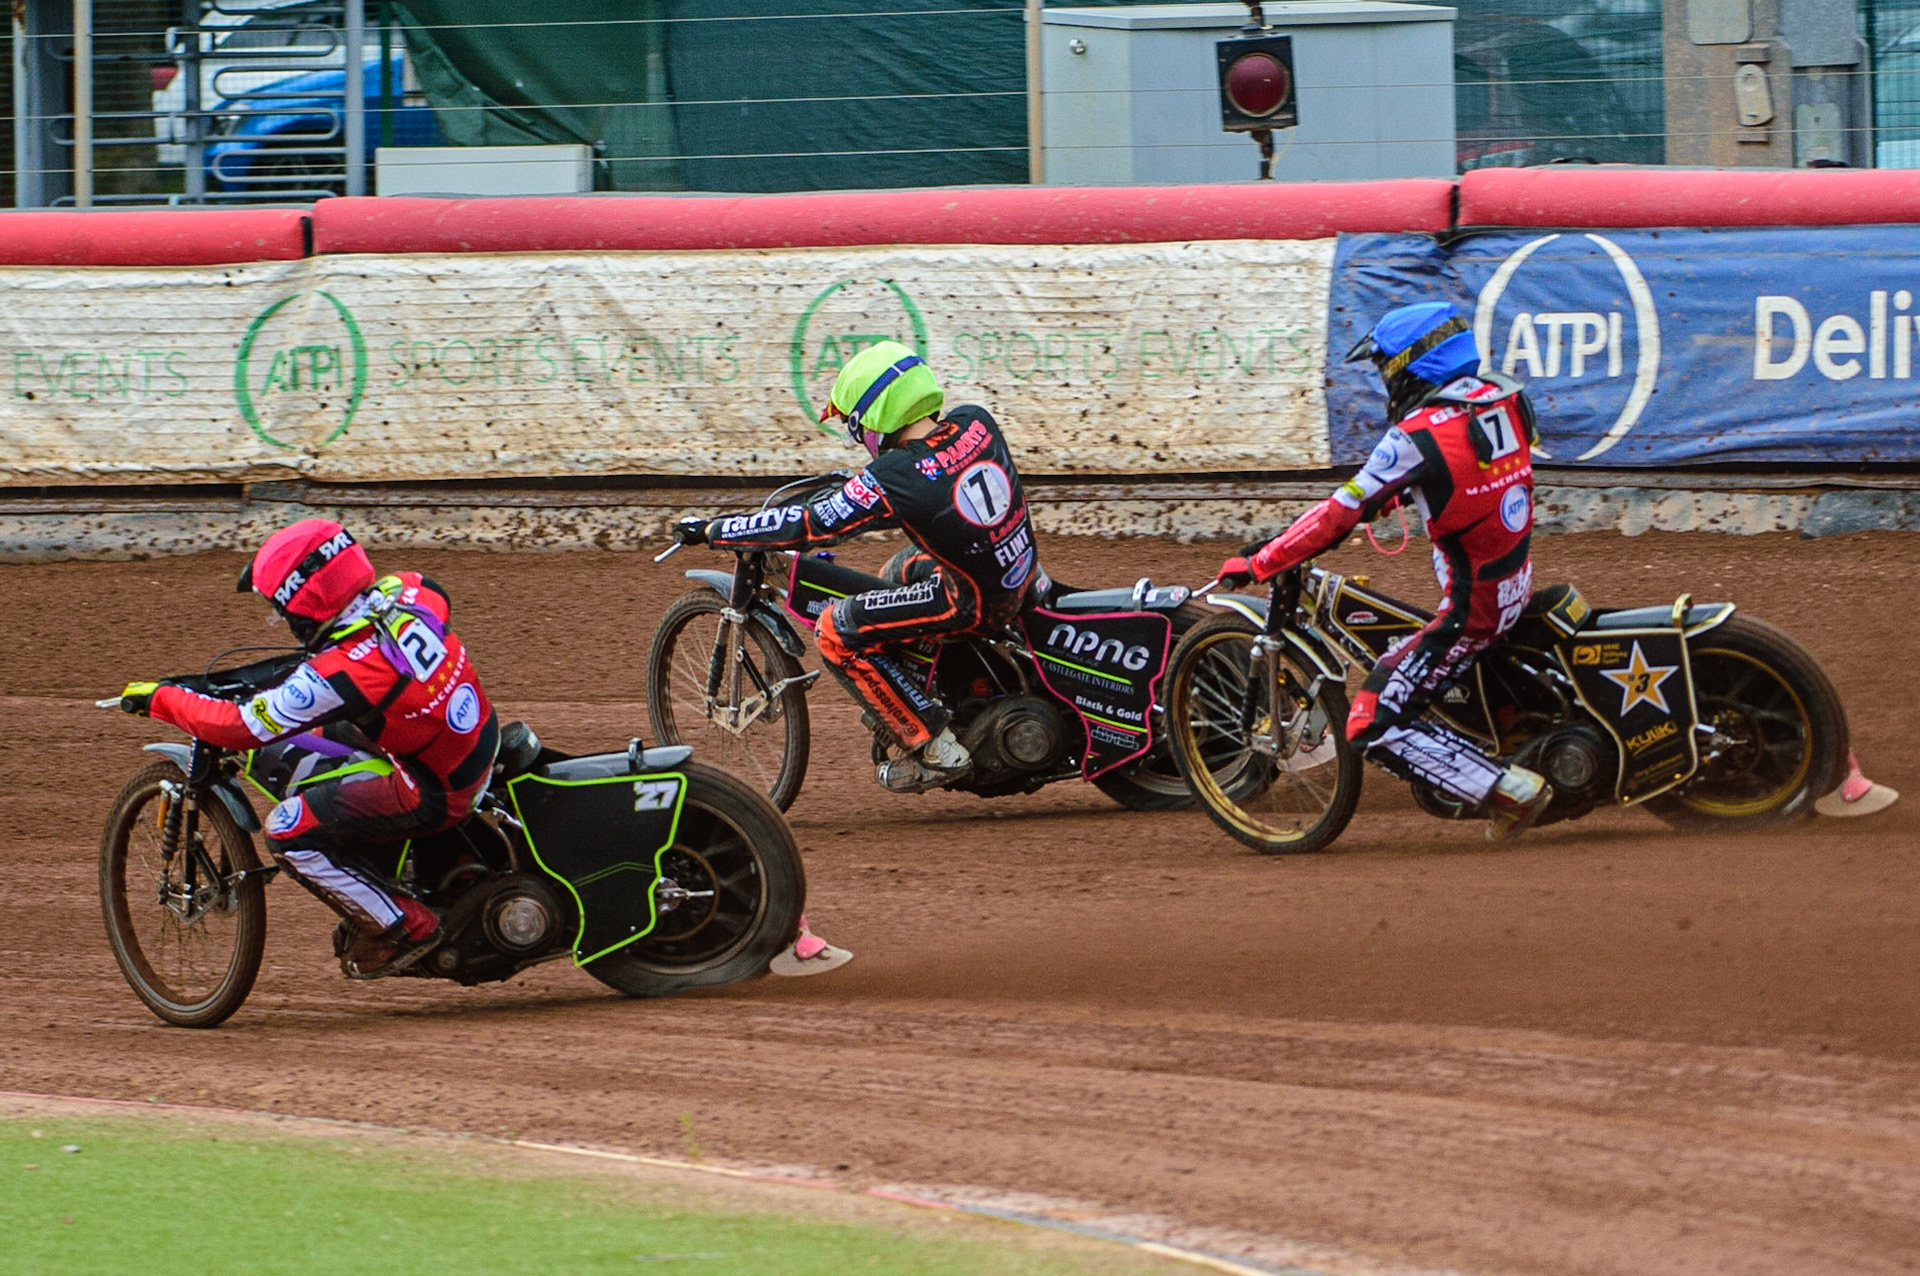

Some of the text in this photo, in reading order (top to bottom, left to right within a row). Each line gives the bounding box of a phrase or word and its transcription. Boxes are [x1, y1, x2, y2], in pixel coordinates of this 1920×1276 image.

[387, 335, 741, 388] SPORTS EVENTS
[948, 328, 1311, 381] SPORTS EVENTS
[1503, 312, 1622, 379] ATPI
[12, 350, 190, 399] EVENTS
[260, 345, 343, 397] ATPI
[935, 419, 987, 468] PARRYS
[1484, 413, 1505, 451] 7
[848, 477, 877, 504] NGK
[968, 470, 996, 518] 7
[995, 527, 1029, 568] FLINT
[402, 631, 438, 672] 2
[1042, 660, 1091, 685] CASTLEGATE
[1091, 673, 1135, 696] INTERIORS
[1075, 695, 1143, 721] Black & Gold
